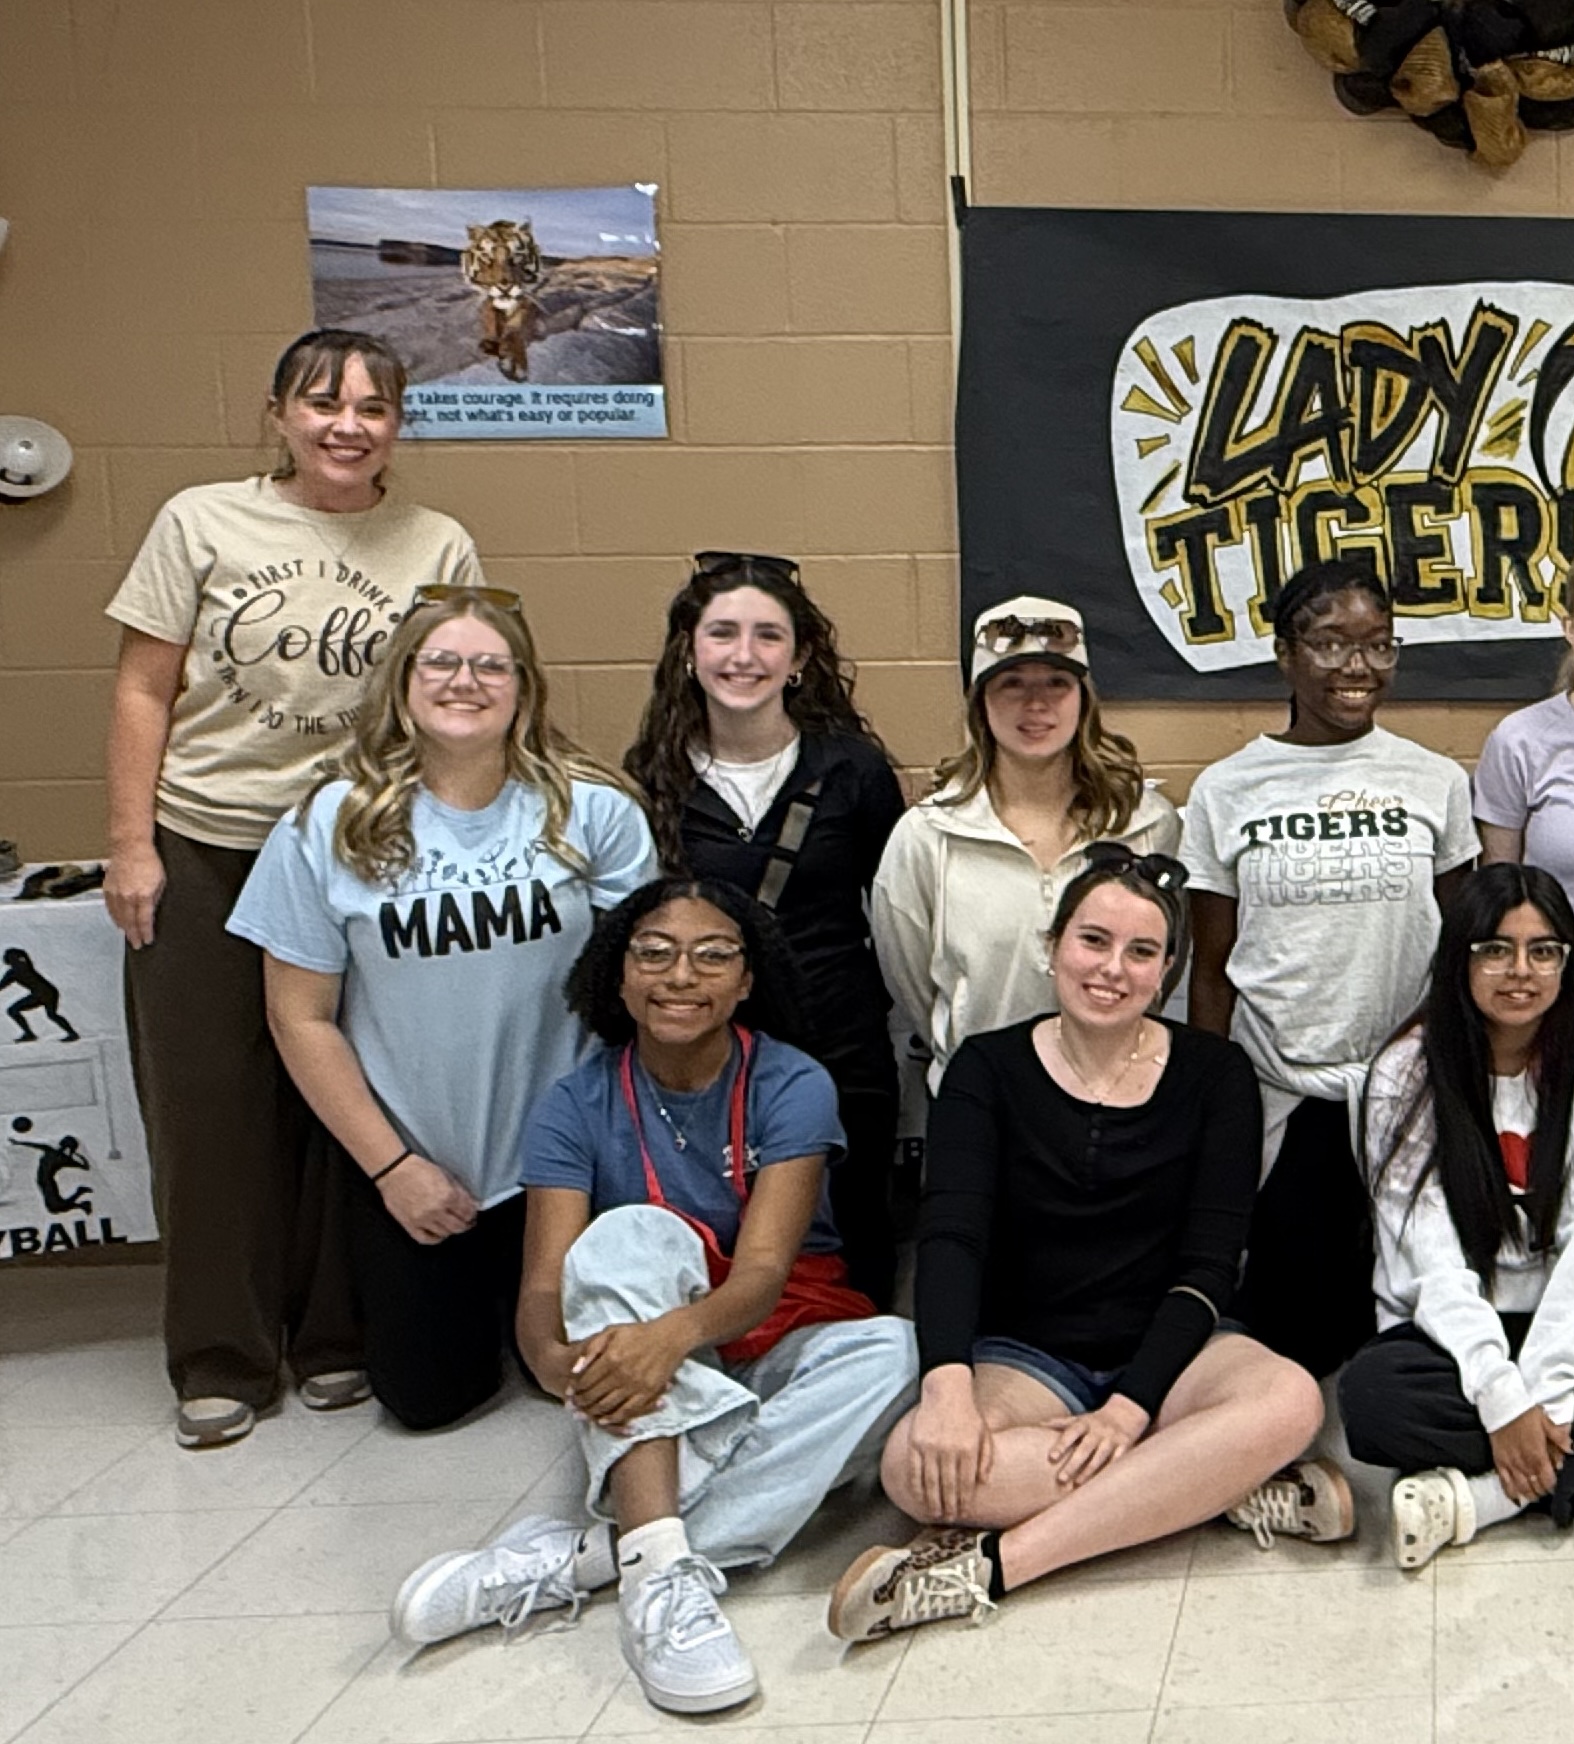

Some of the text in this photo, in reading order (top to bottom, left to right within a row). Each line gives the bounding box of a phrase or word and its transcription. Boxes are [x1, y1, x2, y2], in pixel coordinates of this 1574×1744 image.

[417, 391, 459, 405] takes
[531, 391, 542, 405] It
[546, 391, 609, 408] requires
[612, 390, 655, 408] doing
[436, 408, 462, 422] not
[465, 407, 514, 422] what's
[518, 409, 553, 424] easy
[557, 409, 573, 422] or
[1184, 299, 1519, 503] LADY
[248, 558, 394, 612] FIRST I DRINK
[211, 588, 388, 678] Coffe
[295, 714, 326, 735] THE
[1241, 807, 1408, 846] TIGERS
[379, 878, 563, 959] MAMA
